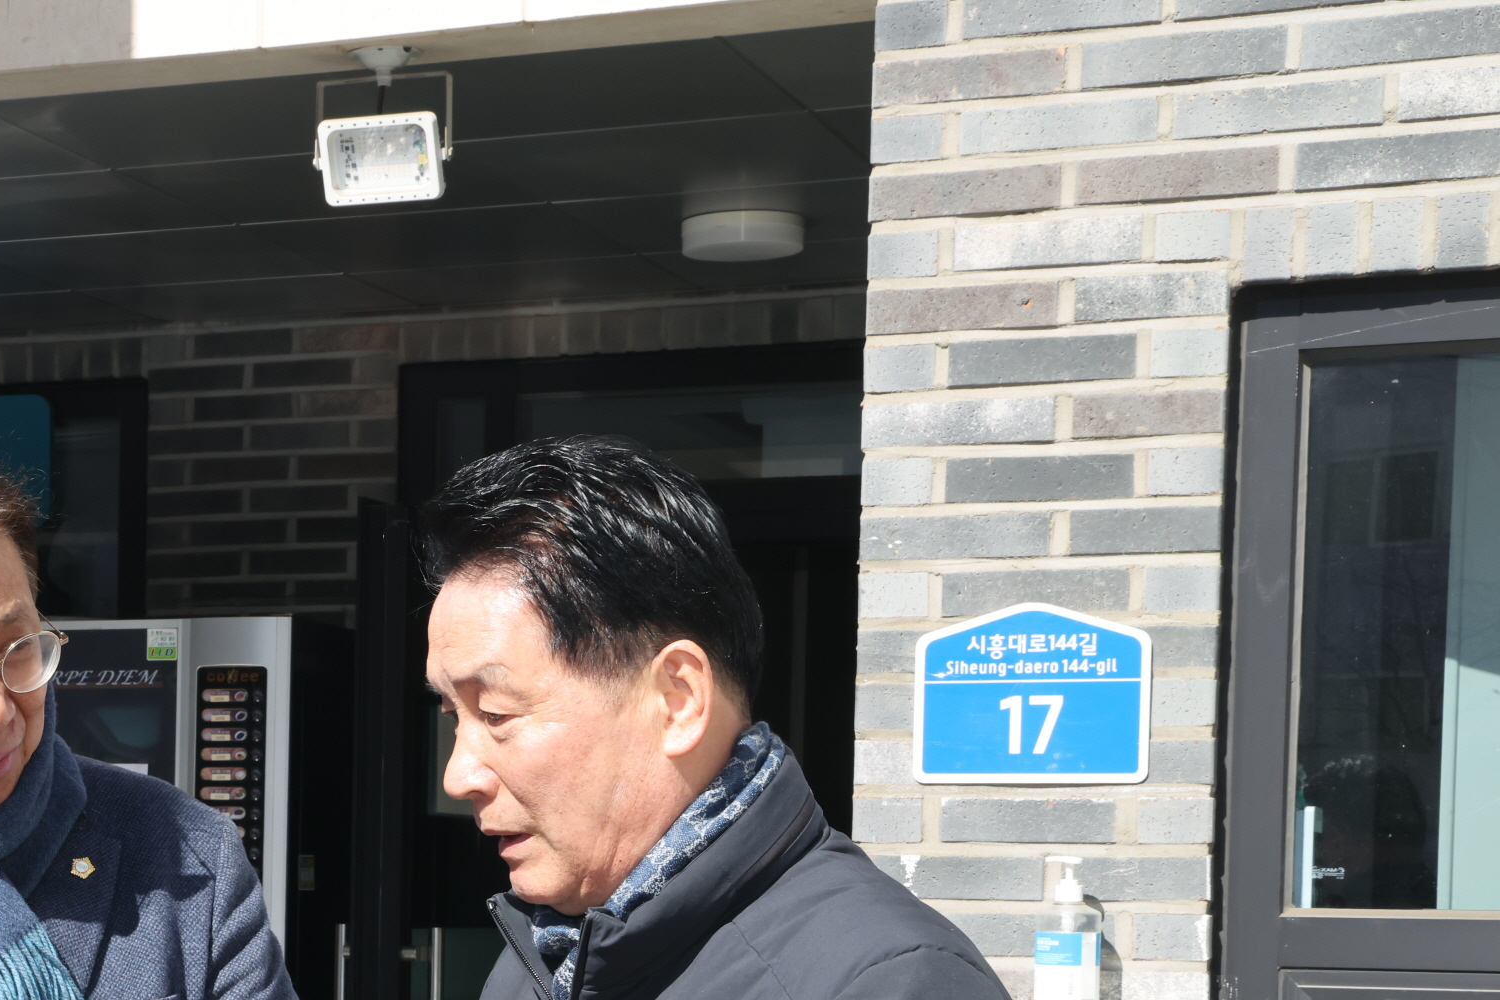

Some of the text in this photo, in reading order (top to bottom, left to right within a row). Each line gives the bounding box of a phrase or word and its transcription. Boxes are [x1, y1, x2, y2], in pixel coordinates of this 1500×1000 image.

[151, 648, 174, 657] LED
[967, 633, 1097, 659] 시흥대로144길
[96, 669, 159, 685] DIEM
[946, 658, 1117, 677] Siheung-daero 144-gil
[1000, 695, 1064, 754] 17
